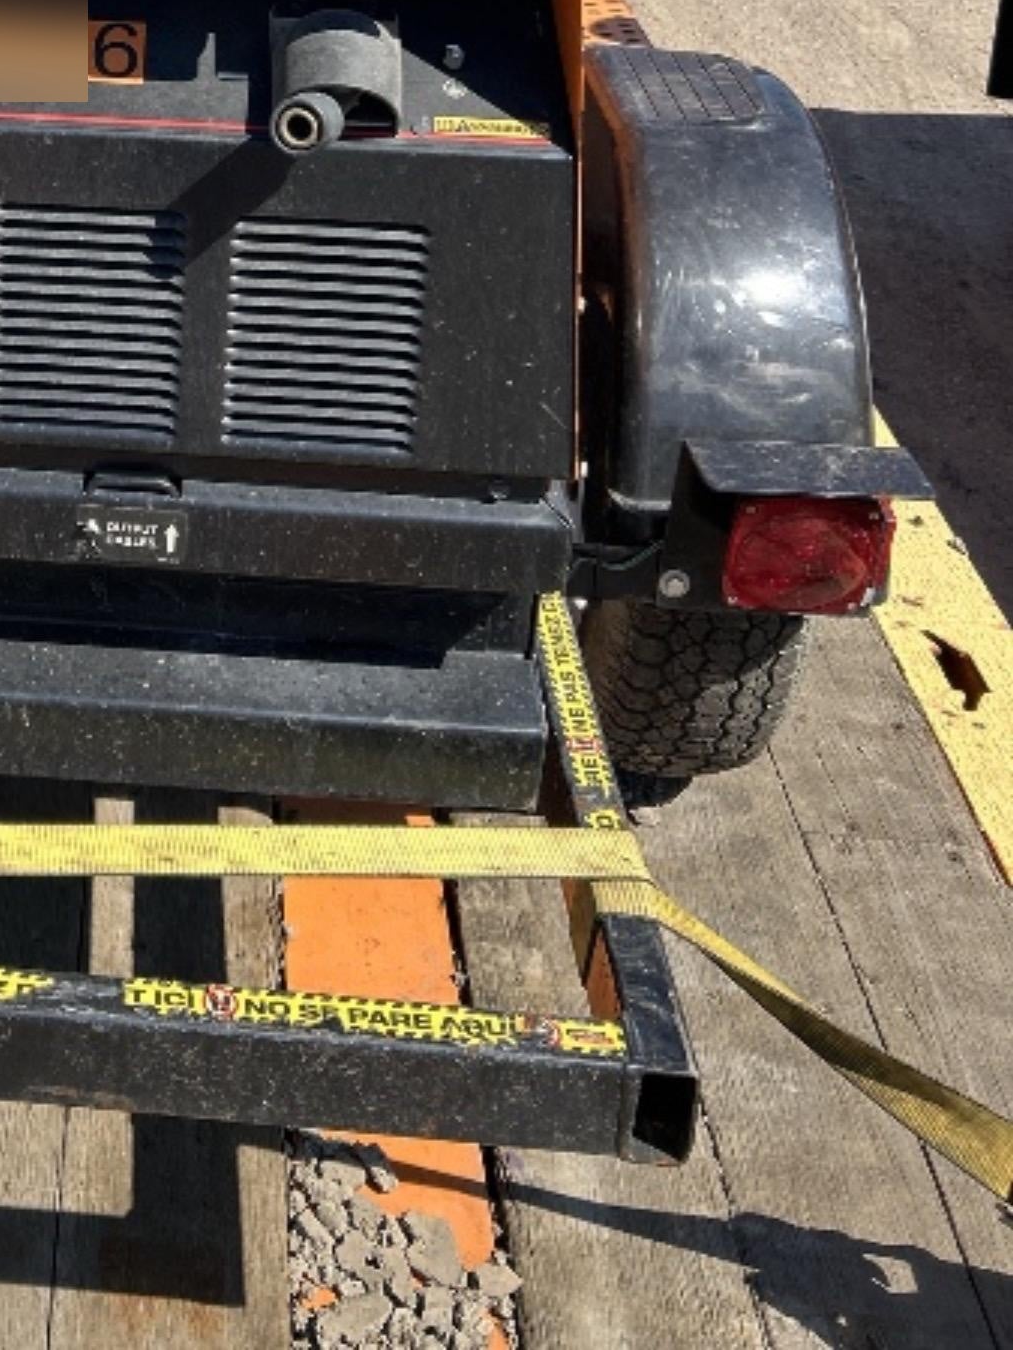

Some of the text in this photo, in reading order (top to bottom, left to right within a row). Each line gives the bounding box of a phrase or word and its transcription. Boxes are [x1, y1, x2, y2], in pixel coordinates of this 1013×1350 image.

[93, 22, 139, 79] 6
[155, 991, 195, 1008] ICI
[245, 999, 290, 1016] NO
[349, 1008, 432, 1030] PARE
